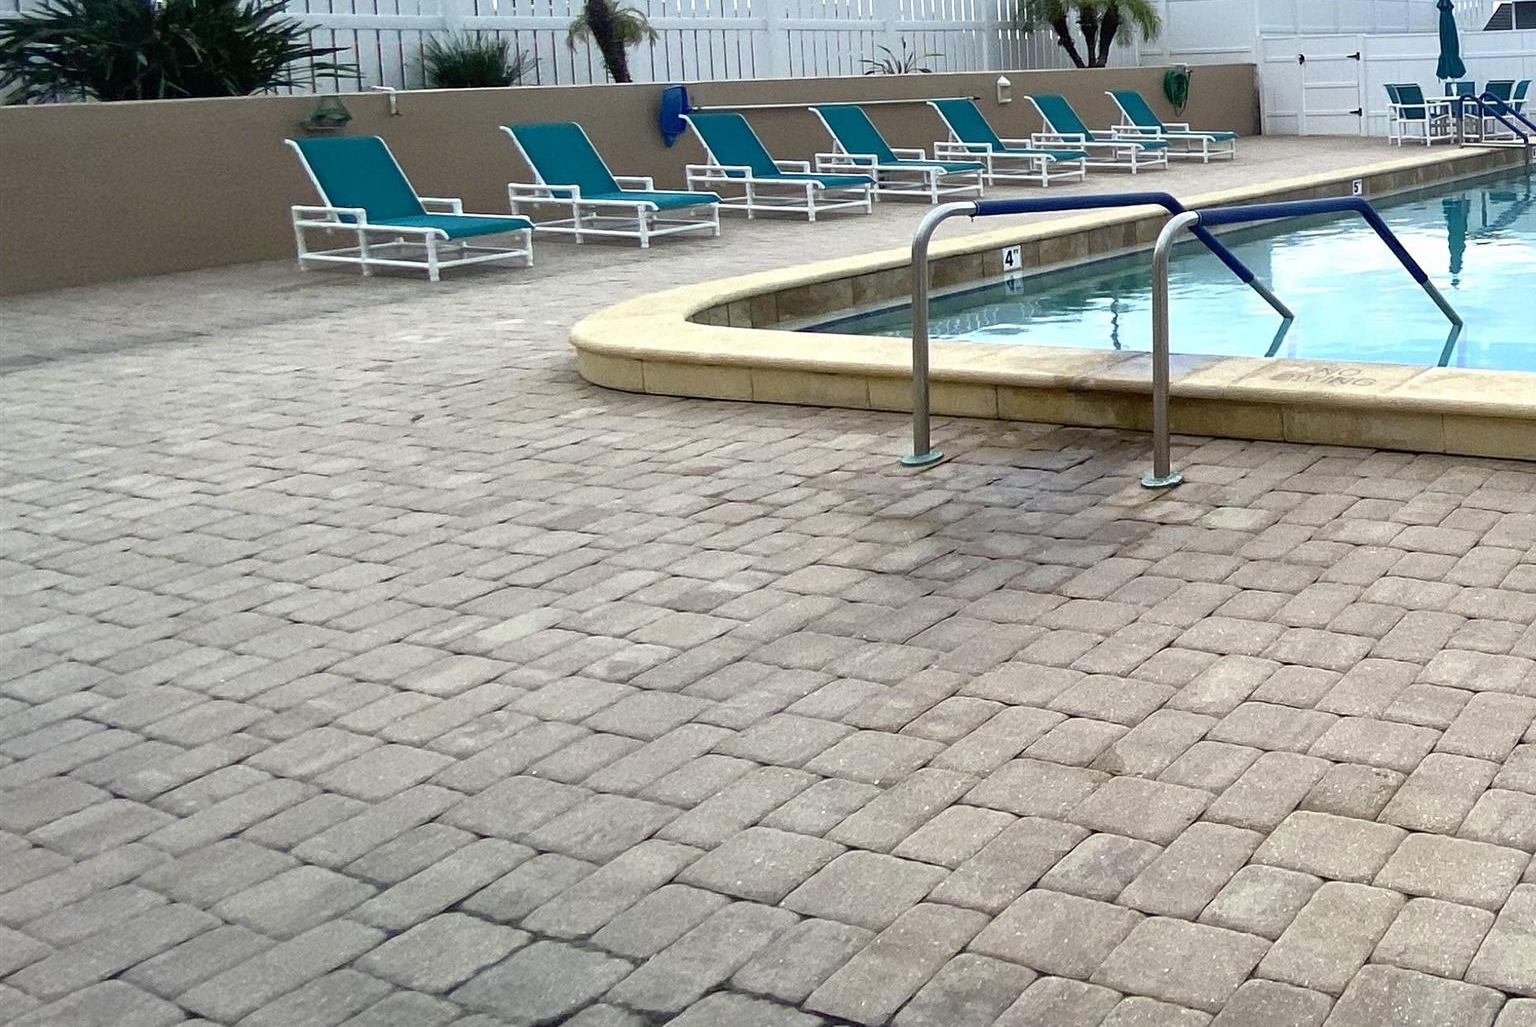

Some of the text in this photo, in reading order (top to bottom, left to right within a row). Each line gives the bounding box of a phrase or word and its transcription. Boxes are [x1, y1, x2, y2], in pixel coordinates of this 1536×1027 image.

[1353, 181, 1359, 194] 5
[1317, 367, 1361, 377] NO
[1269, 373, 1377, 387] DIVING
